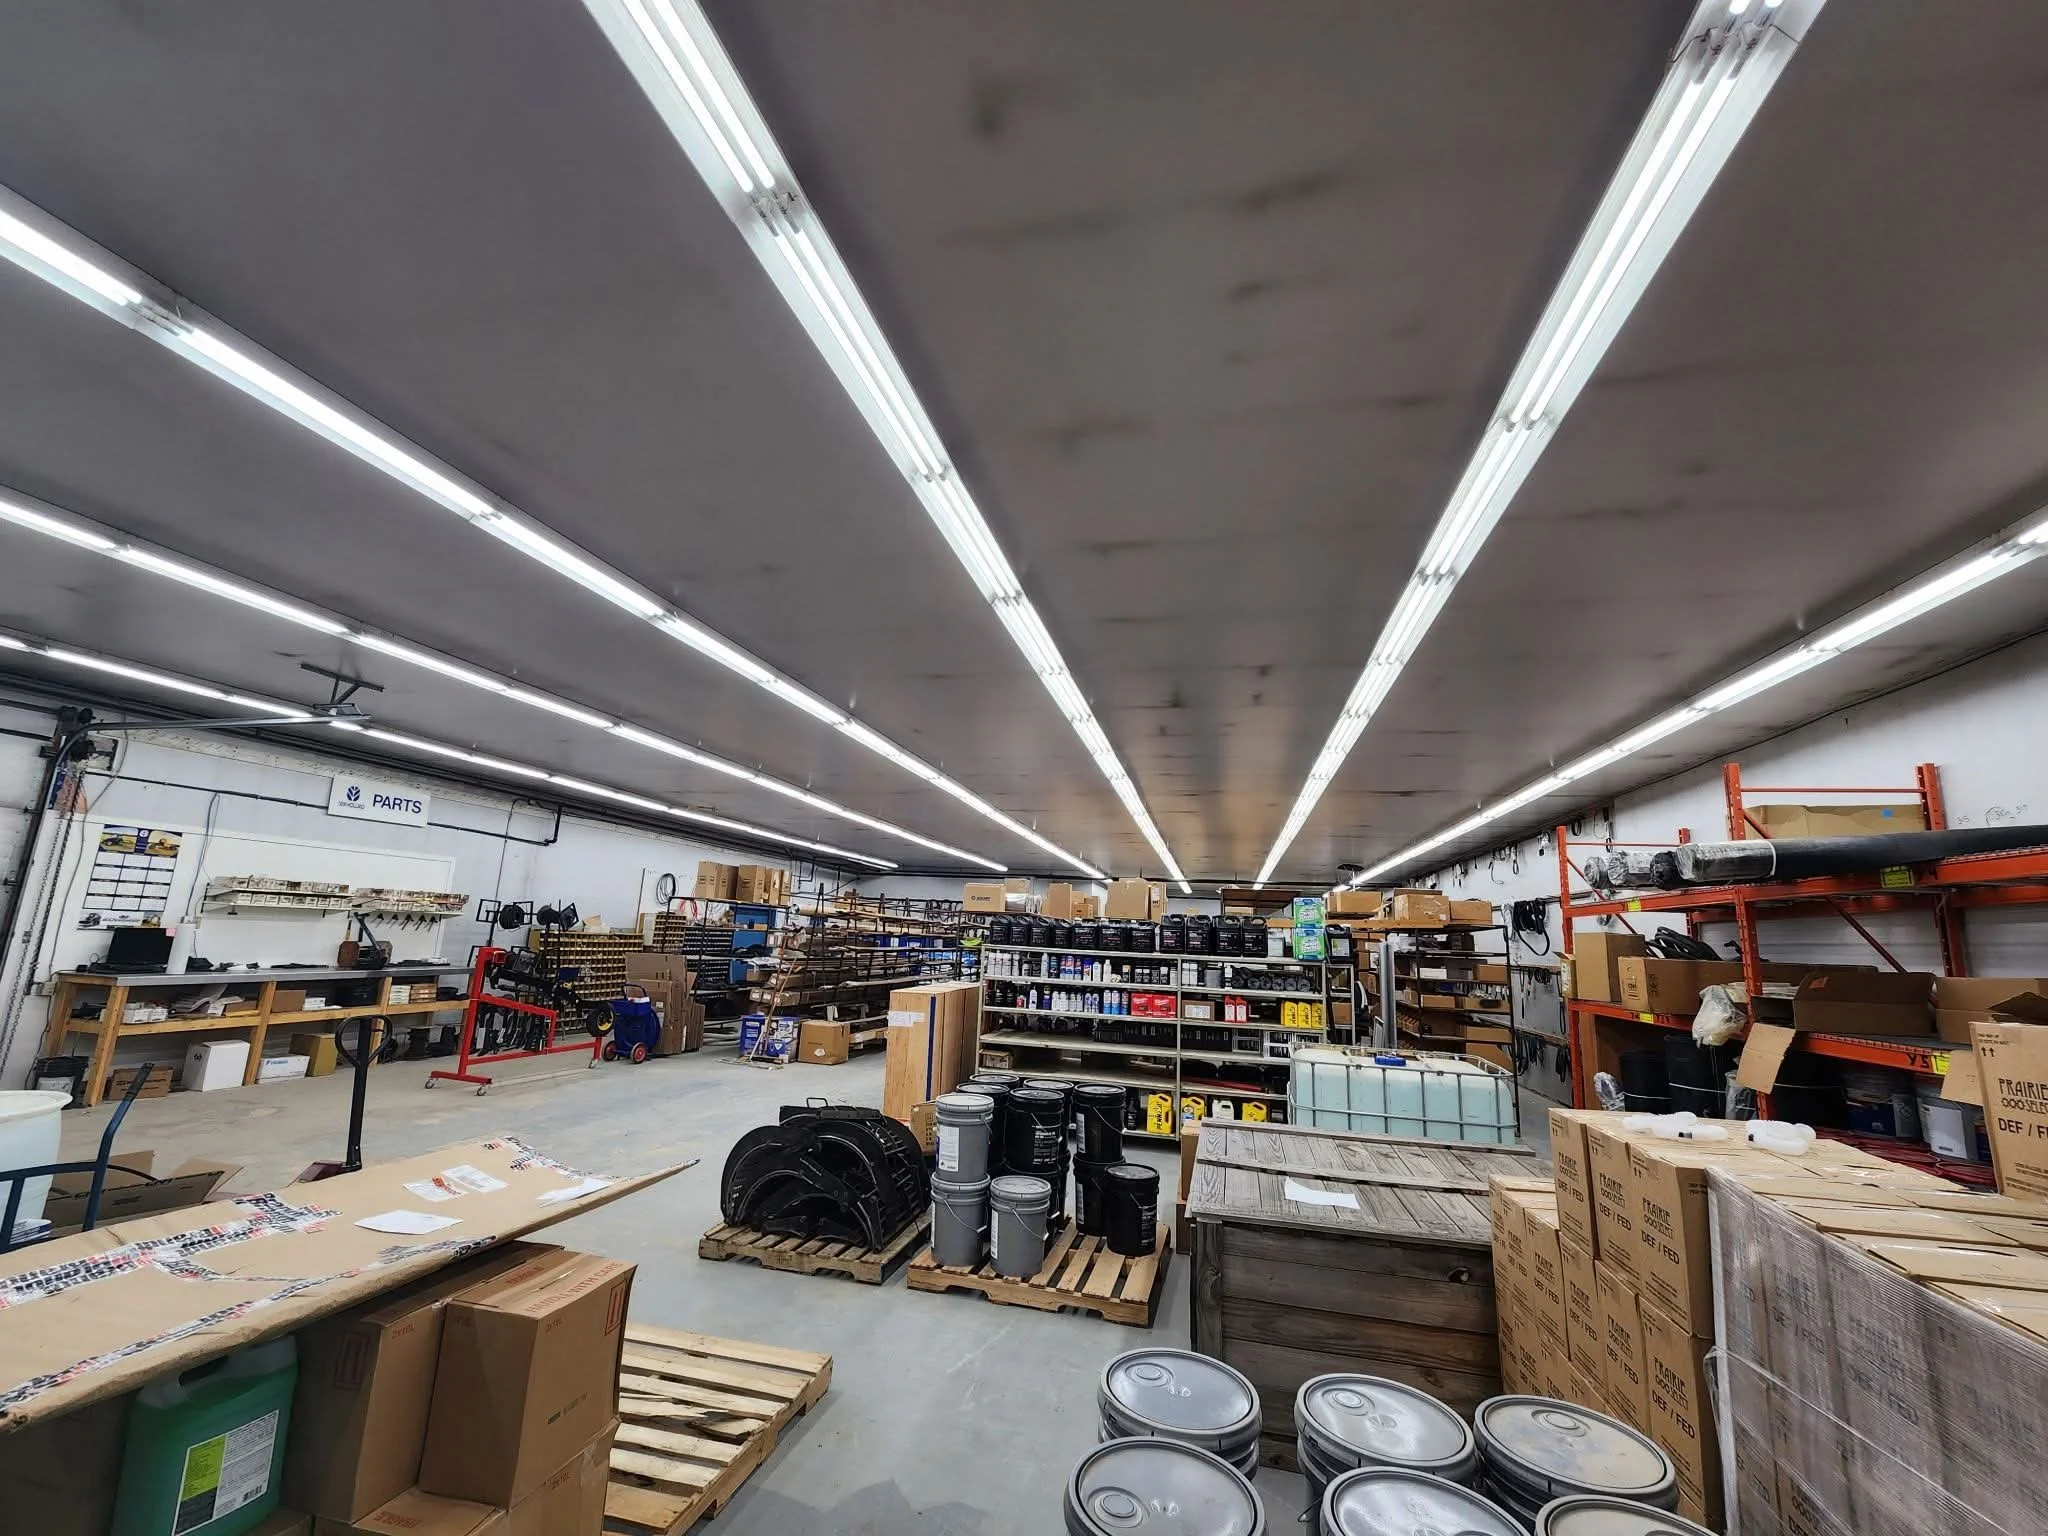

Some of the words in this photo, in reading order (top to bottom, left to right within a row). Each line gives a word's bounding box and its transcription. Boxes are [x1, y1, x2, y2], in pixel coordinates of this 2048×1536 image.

[372, 794, 422, 814] PARTS
[1998, 1078, 2048, 1101] PRAIRIE
[1998, 1117, 2023, 1135] DEF
[1600, 1202, 1612, 1218] DEF
[1617, 1215, 1631, 1231] FED
[1641, 1230, 1656, 1249] DEF
[1663, 1244, 1679, 1265] FED
[1652, 1389, 1668, 1413] DEF
[1676, 1411, 1695, 1440] FED
